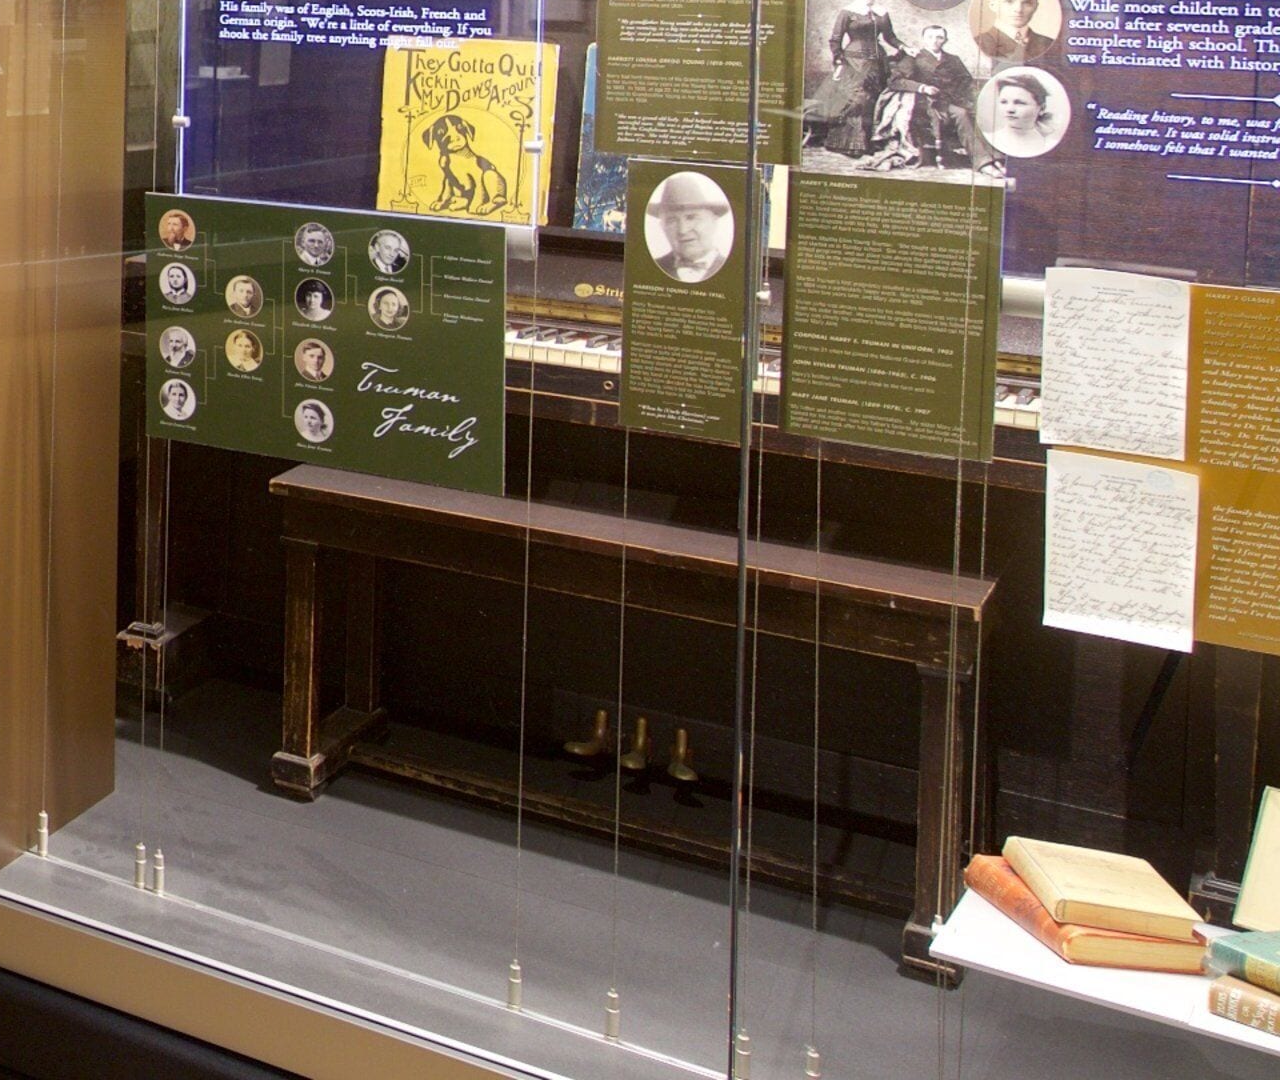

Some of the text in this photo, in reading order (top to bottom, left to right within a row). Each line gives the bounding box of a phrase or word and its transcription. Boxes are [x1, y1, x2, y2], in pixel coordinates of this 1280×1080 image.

[220, 0, 486, 20] His family was of English, Scots-Irish, French and
[1124, 2, 1165, 14] most
[1170, 1, 1238, 16] children
[1245, 3, 1261, 16] in
[1067, 15, 1229, 34] school after seventh
[1066, 32, 1247, 54] complete high school.
[448, 51, 494, 74] Gotta
[1067, 51, 1224, 69] was fascinated with
[421, 89, 445, 111] My
[357, 362, 460, 402] Truman
[373, 403, 478, 459] Family
